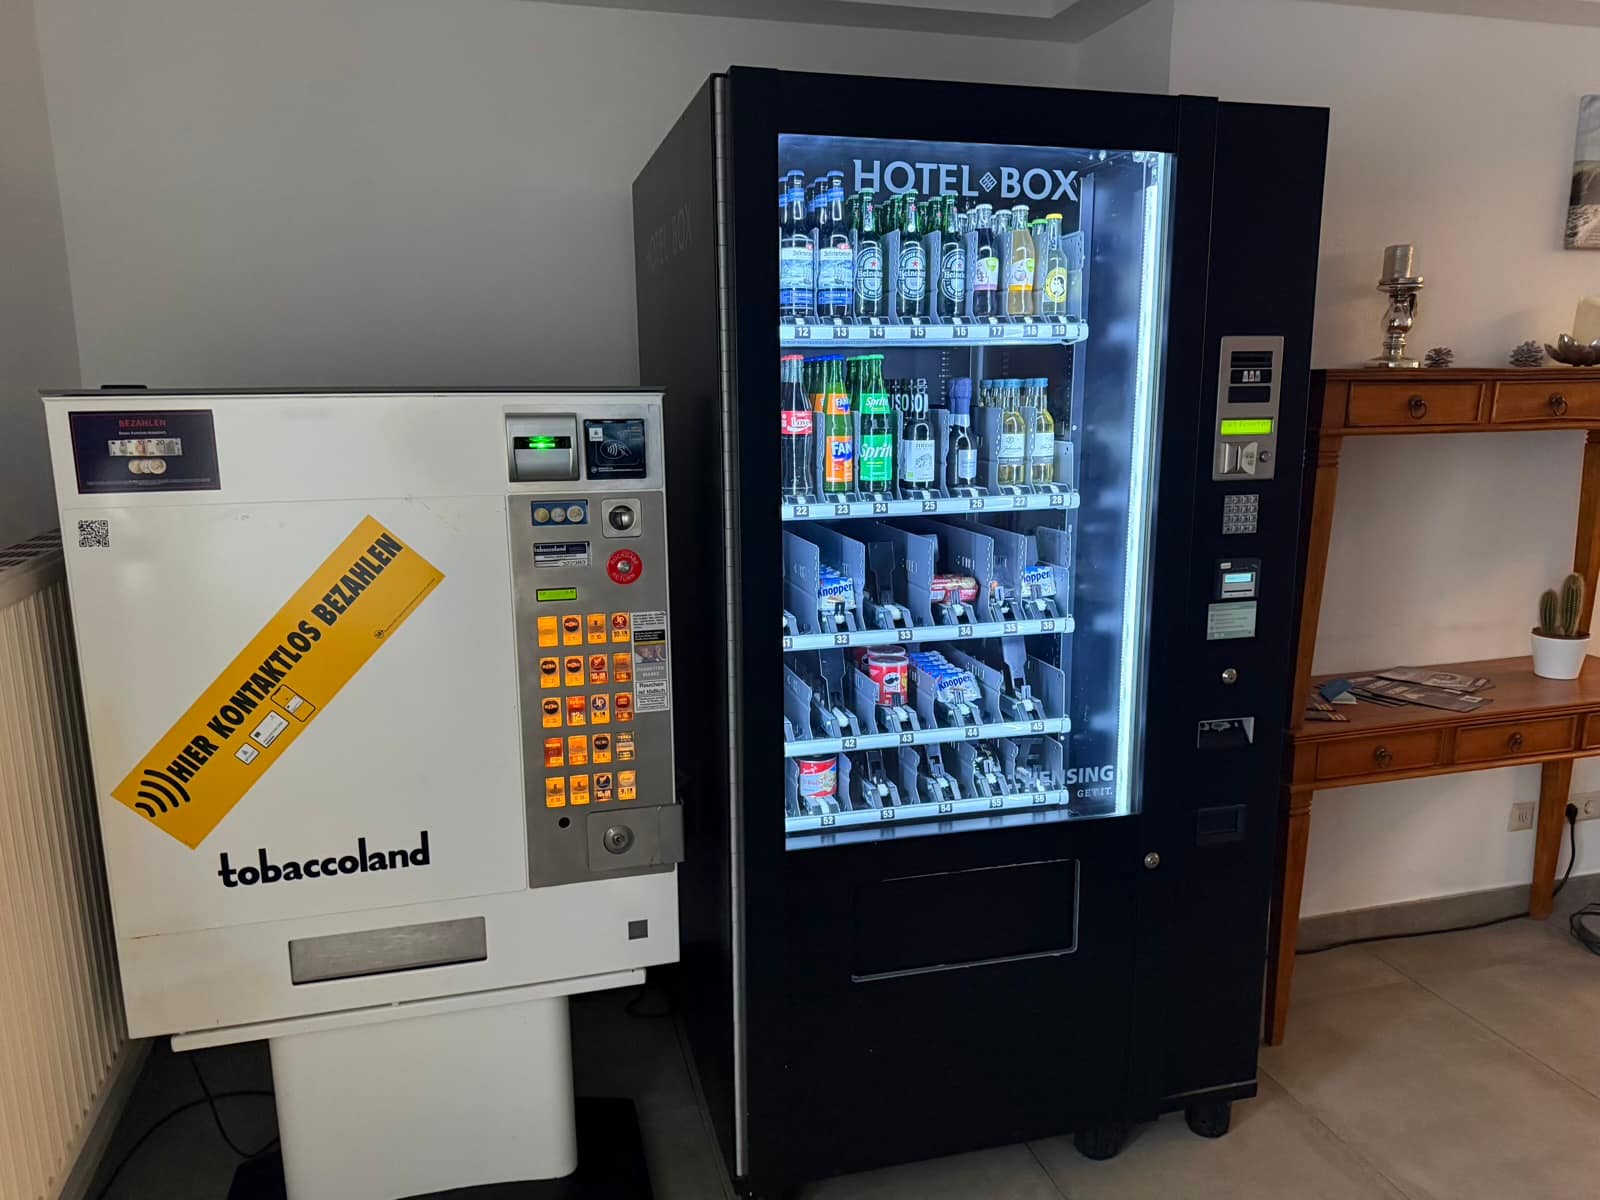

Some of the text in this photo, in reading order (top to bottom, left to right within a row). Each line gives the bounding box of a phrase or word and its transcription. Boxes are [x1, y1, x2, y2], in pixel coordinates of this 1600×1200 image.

[853, 159, 1079, 201] HOTEL BOX
[798, 328, 809, 336] 12
[837, 328, 847, 336] 13
[873, 328, 883, 336] 14
[914, 328, 924, 336] 15
[956, 328, 967, 336] 16
[992, 327, 1003, 335] 17
[1055, 326, 1065, 334] 19
[831, 441, 853, 456] FAN
[971, 499, 983, 507] 26
[1052, 495, 1063, 504] 28
[837, 505, 848, 514] 23
[875, 503, 887, 512] 24
[924, 501, 935, 510] 25
[796, 506, 807, 515] 22
[817, 583, 852, 599] Knopper
[1005, 624, 1016, 632] 35
[1042, 621, 1054, 629] 36
[900, 631, 911, 639] 33
[960, 627, 971, 635] 34
[836, 635, 848, 643] 32
[166, 532, 404, 783] HIER KONTAKTLOS BEZAHLEN
[1033, 722, 1043, 730] 45
[967, 729, 978, 737] 44
[902, 734, 912, 742] 43
[844, 740, 855, 748] 42
[991, 799, 1001, 807] 55
[1035, 795, 1045, 803] 56
[940, 804, 951, 812] 54
[883, 810, 893, 818] 53
[823, 817, 834, 825] 52
[218, 830, 431, 888] tobaccoland
